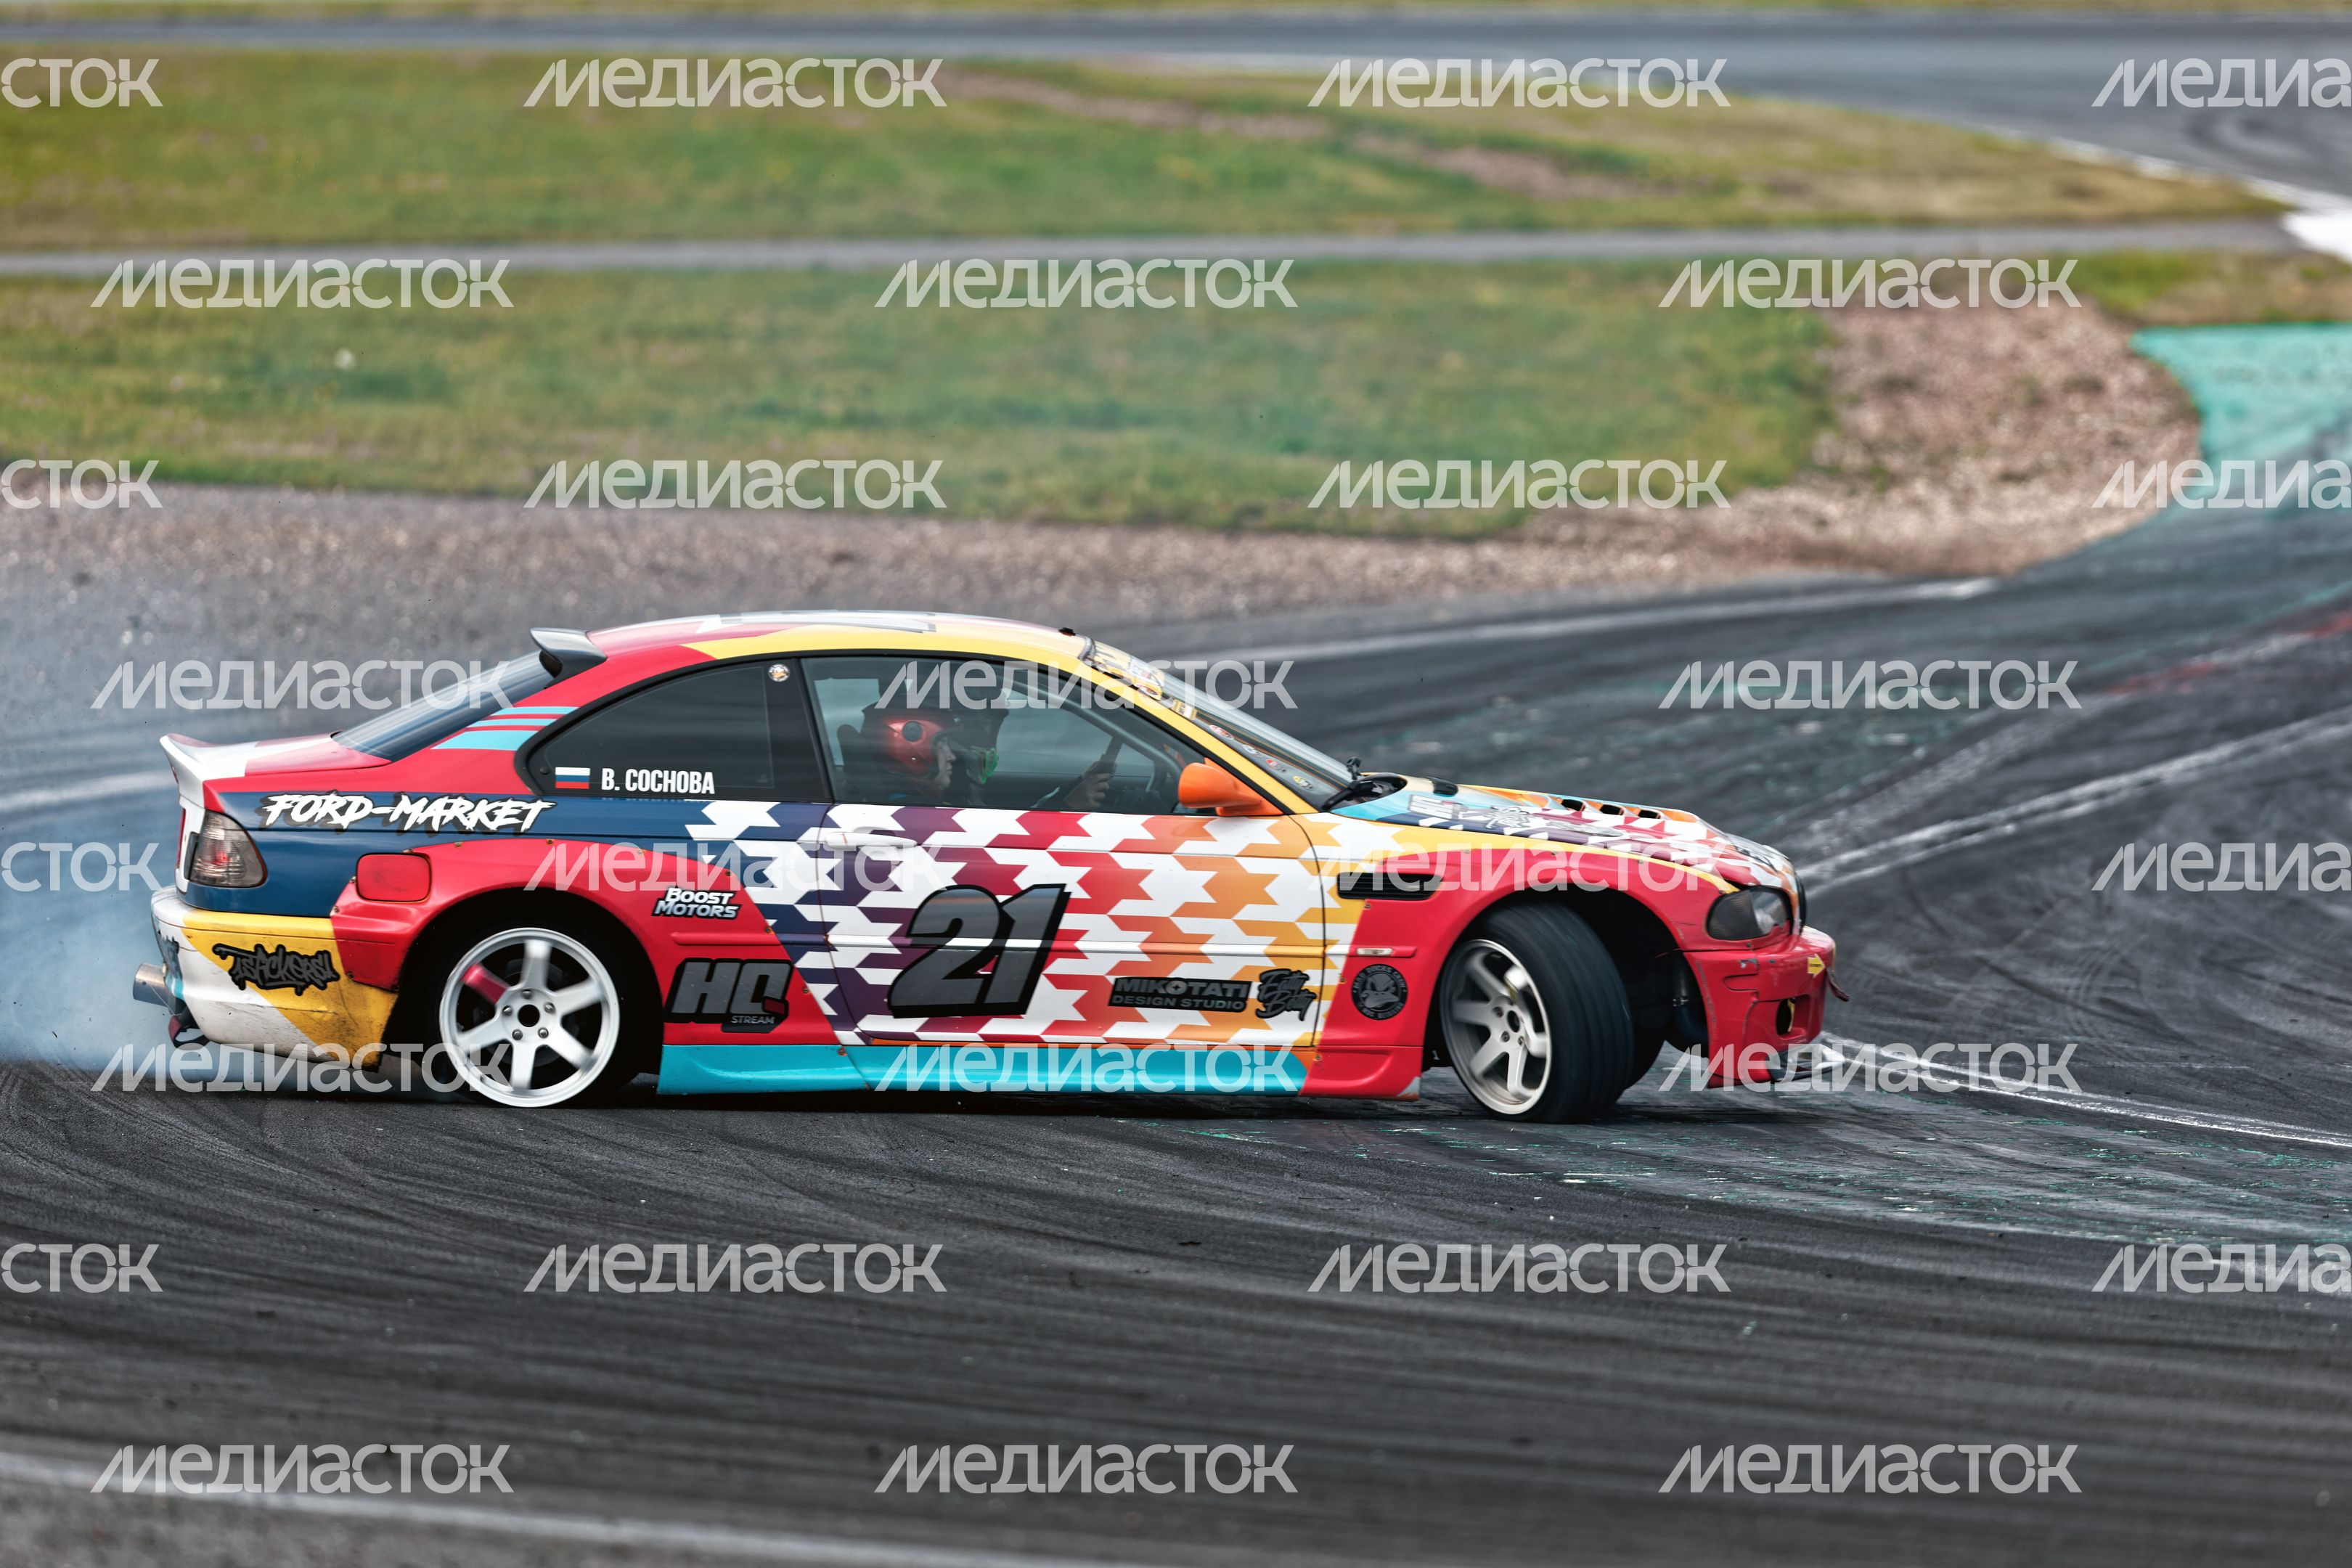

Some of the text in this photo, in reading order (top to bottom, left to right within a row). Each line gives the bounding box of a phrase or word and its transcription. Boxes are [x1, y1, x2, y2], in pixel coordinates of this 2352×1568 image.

[625, 768, 715, 794] СОСНОВА
[264, 794, 557, 833] FORD-MARKET
[888, 884, 1069, 1016] 21
[671, 961, 791, 1015] HQ
[1114, 978, 1247, 998] MIKOTATI
[1112, 995, 1246, 1010] DESIGN STUDIO
[730, 1016, 775, 1024] STREAM
